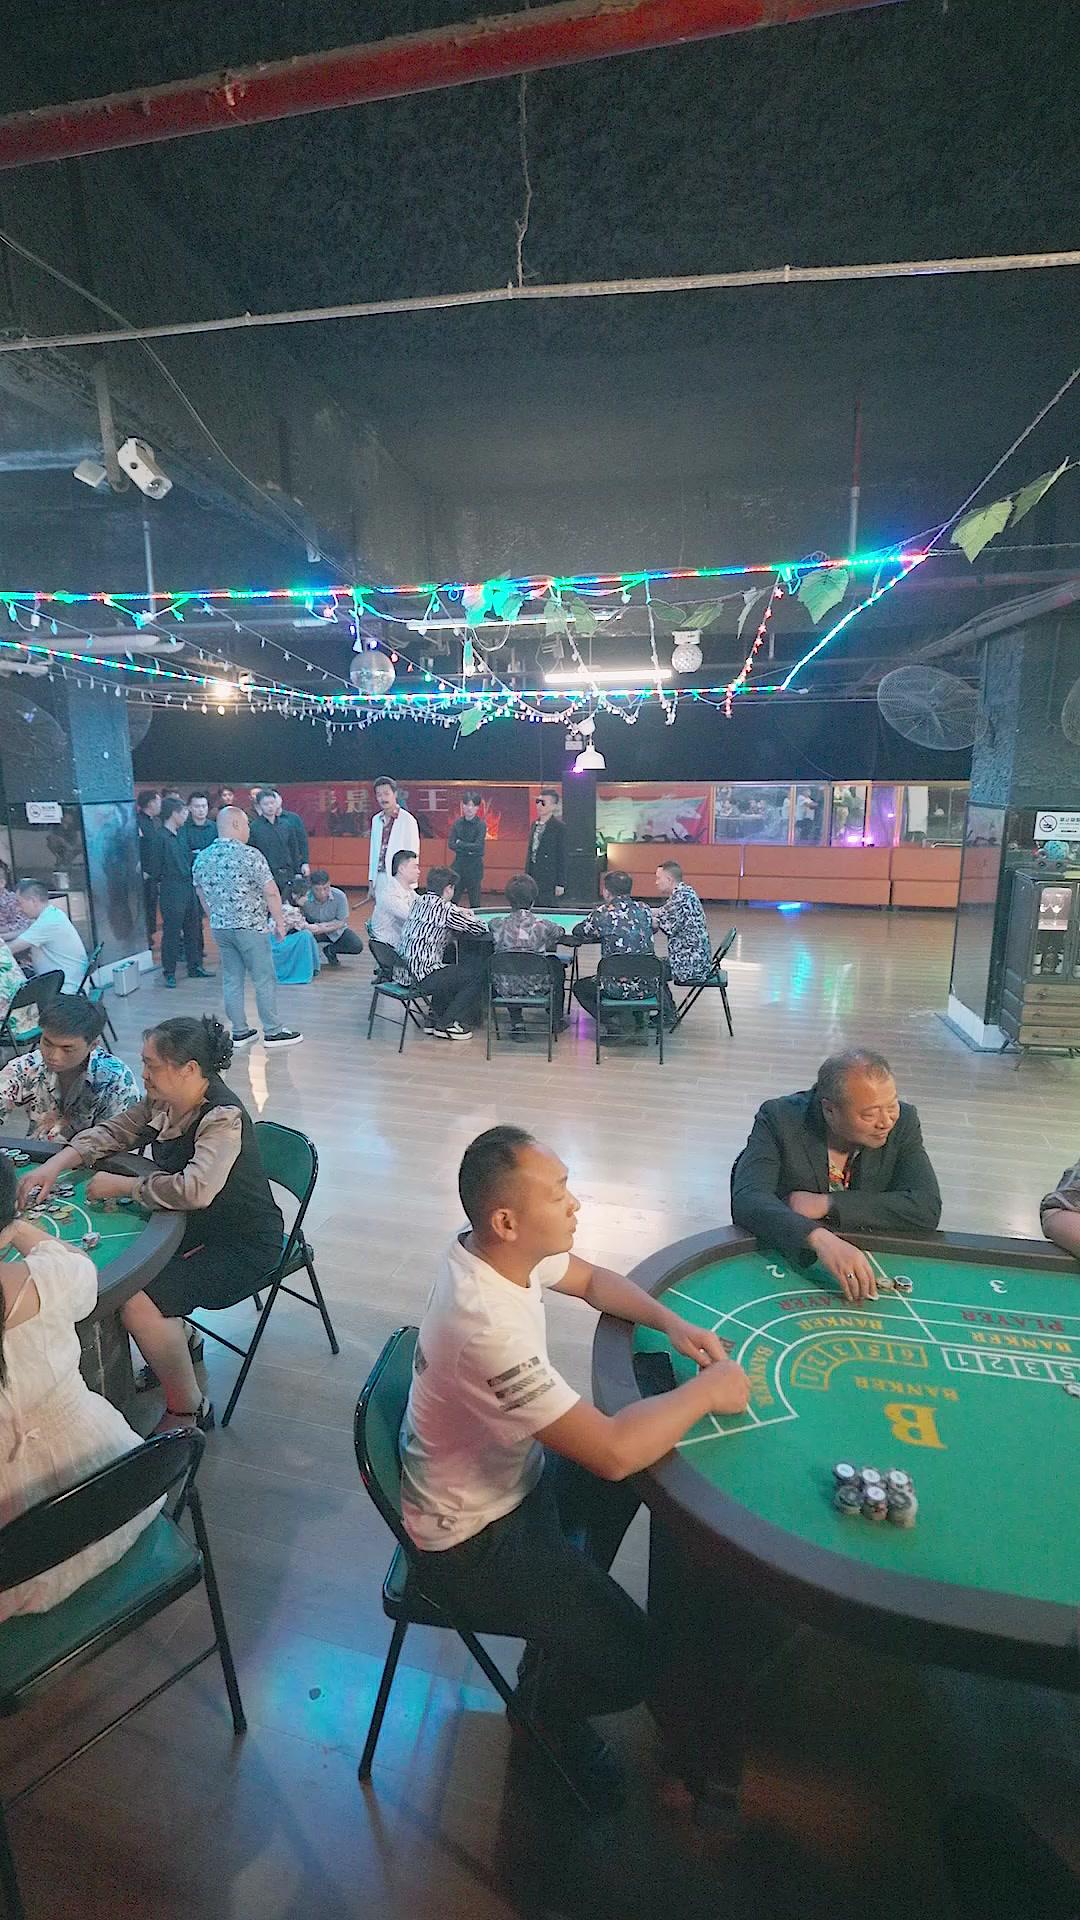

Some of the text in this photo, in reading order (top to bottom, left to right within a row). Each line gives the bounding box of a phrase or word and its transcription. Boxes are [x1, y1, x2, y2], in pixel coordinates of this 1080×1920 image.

[766, 1265, 785, 1278] 2
[989, 1279, 1008, 1294] 3
[799, 1316, 883, 1330] BANKER
[961, 1311, 1064, 1331] PLAYER
[970, 1331, 1072, 1353] BANKER
[957, 1353, 1076, 1379] 1 2 3 5
[855, 1376, 959, 1401] BANKER
[884, 1402, 948, 1449] B
